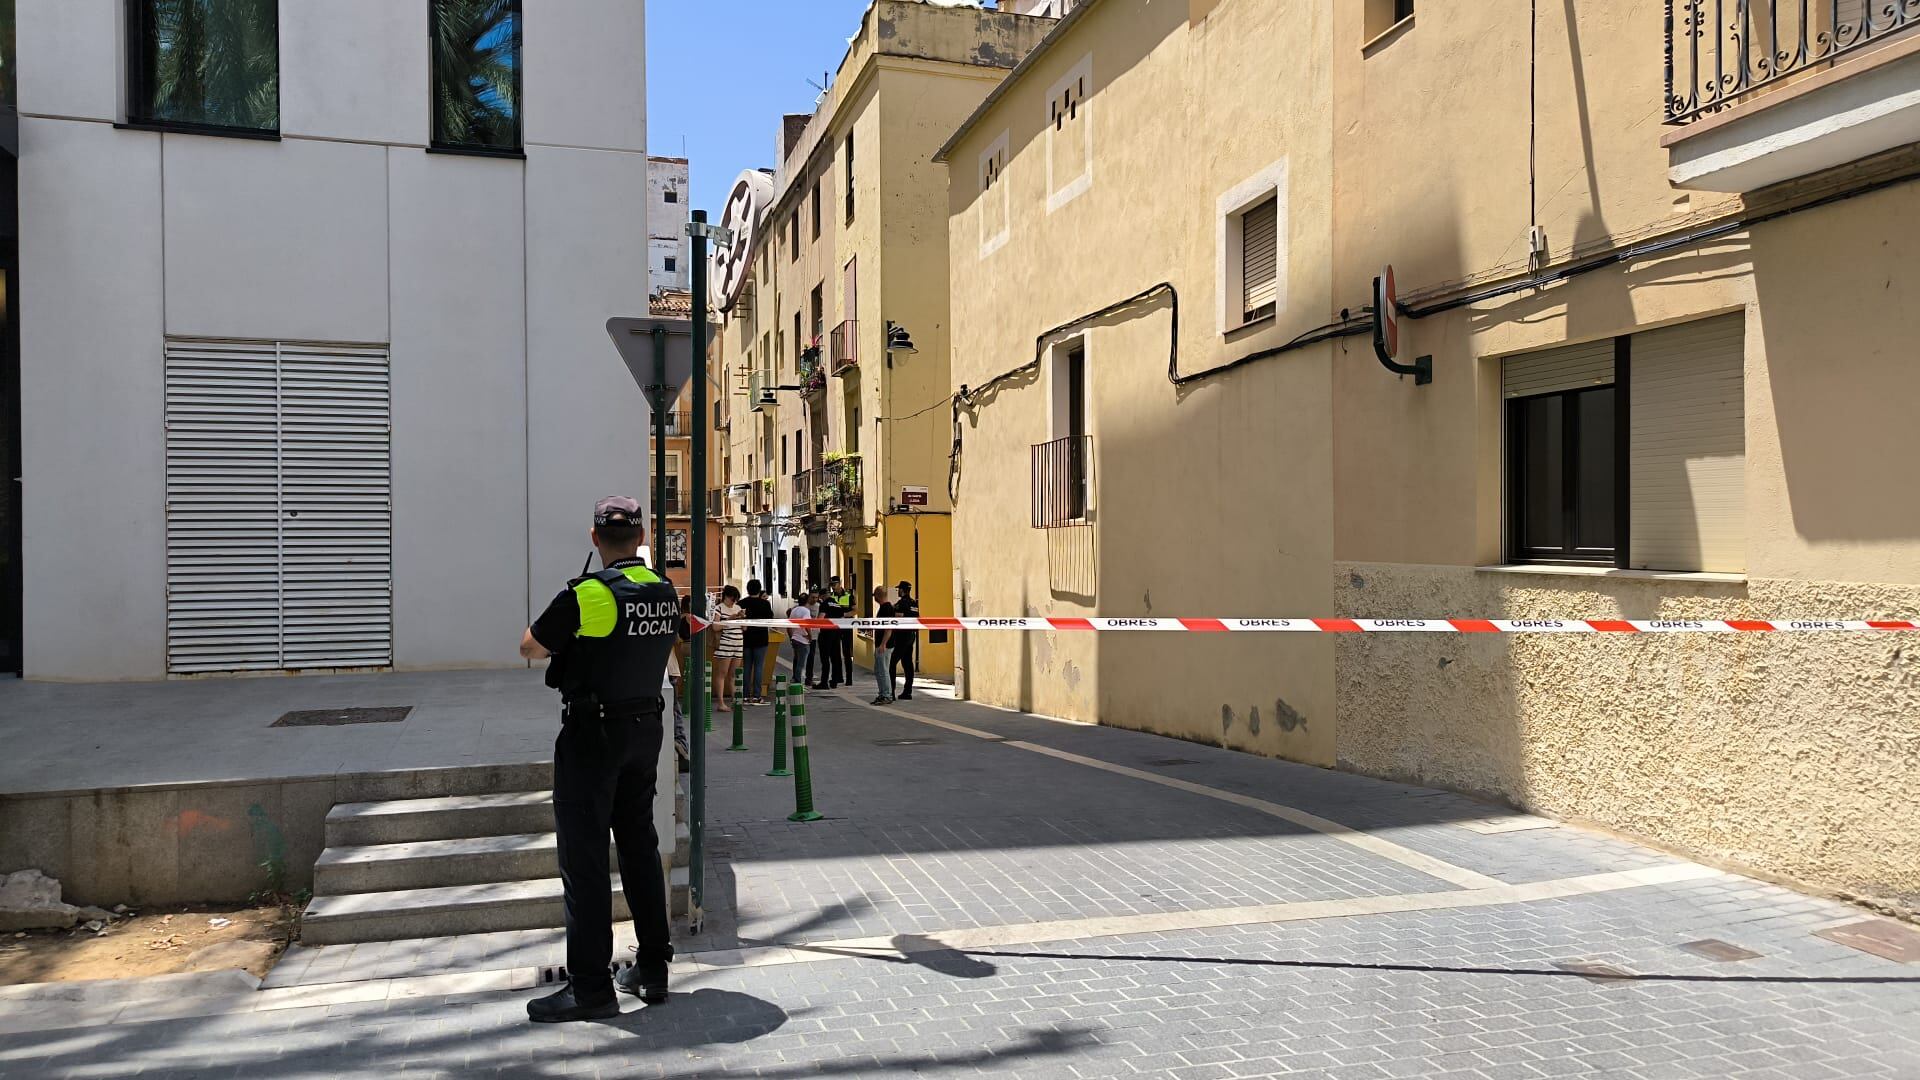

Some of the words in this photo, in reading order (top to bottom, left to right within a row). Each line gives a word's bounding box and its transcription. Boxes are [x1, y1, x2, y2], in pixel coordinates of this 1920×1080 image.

[625, 601, 679, 618] POLICIA
[627, 619, 674, 636] LOCAL
[1107, 619, 1158, 627] OBRES
